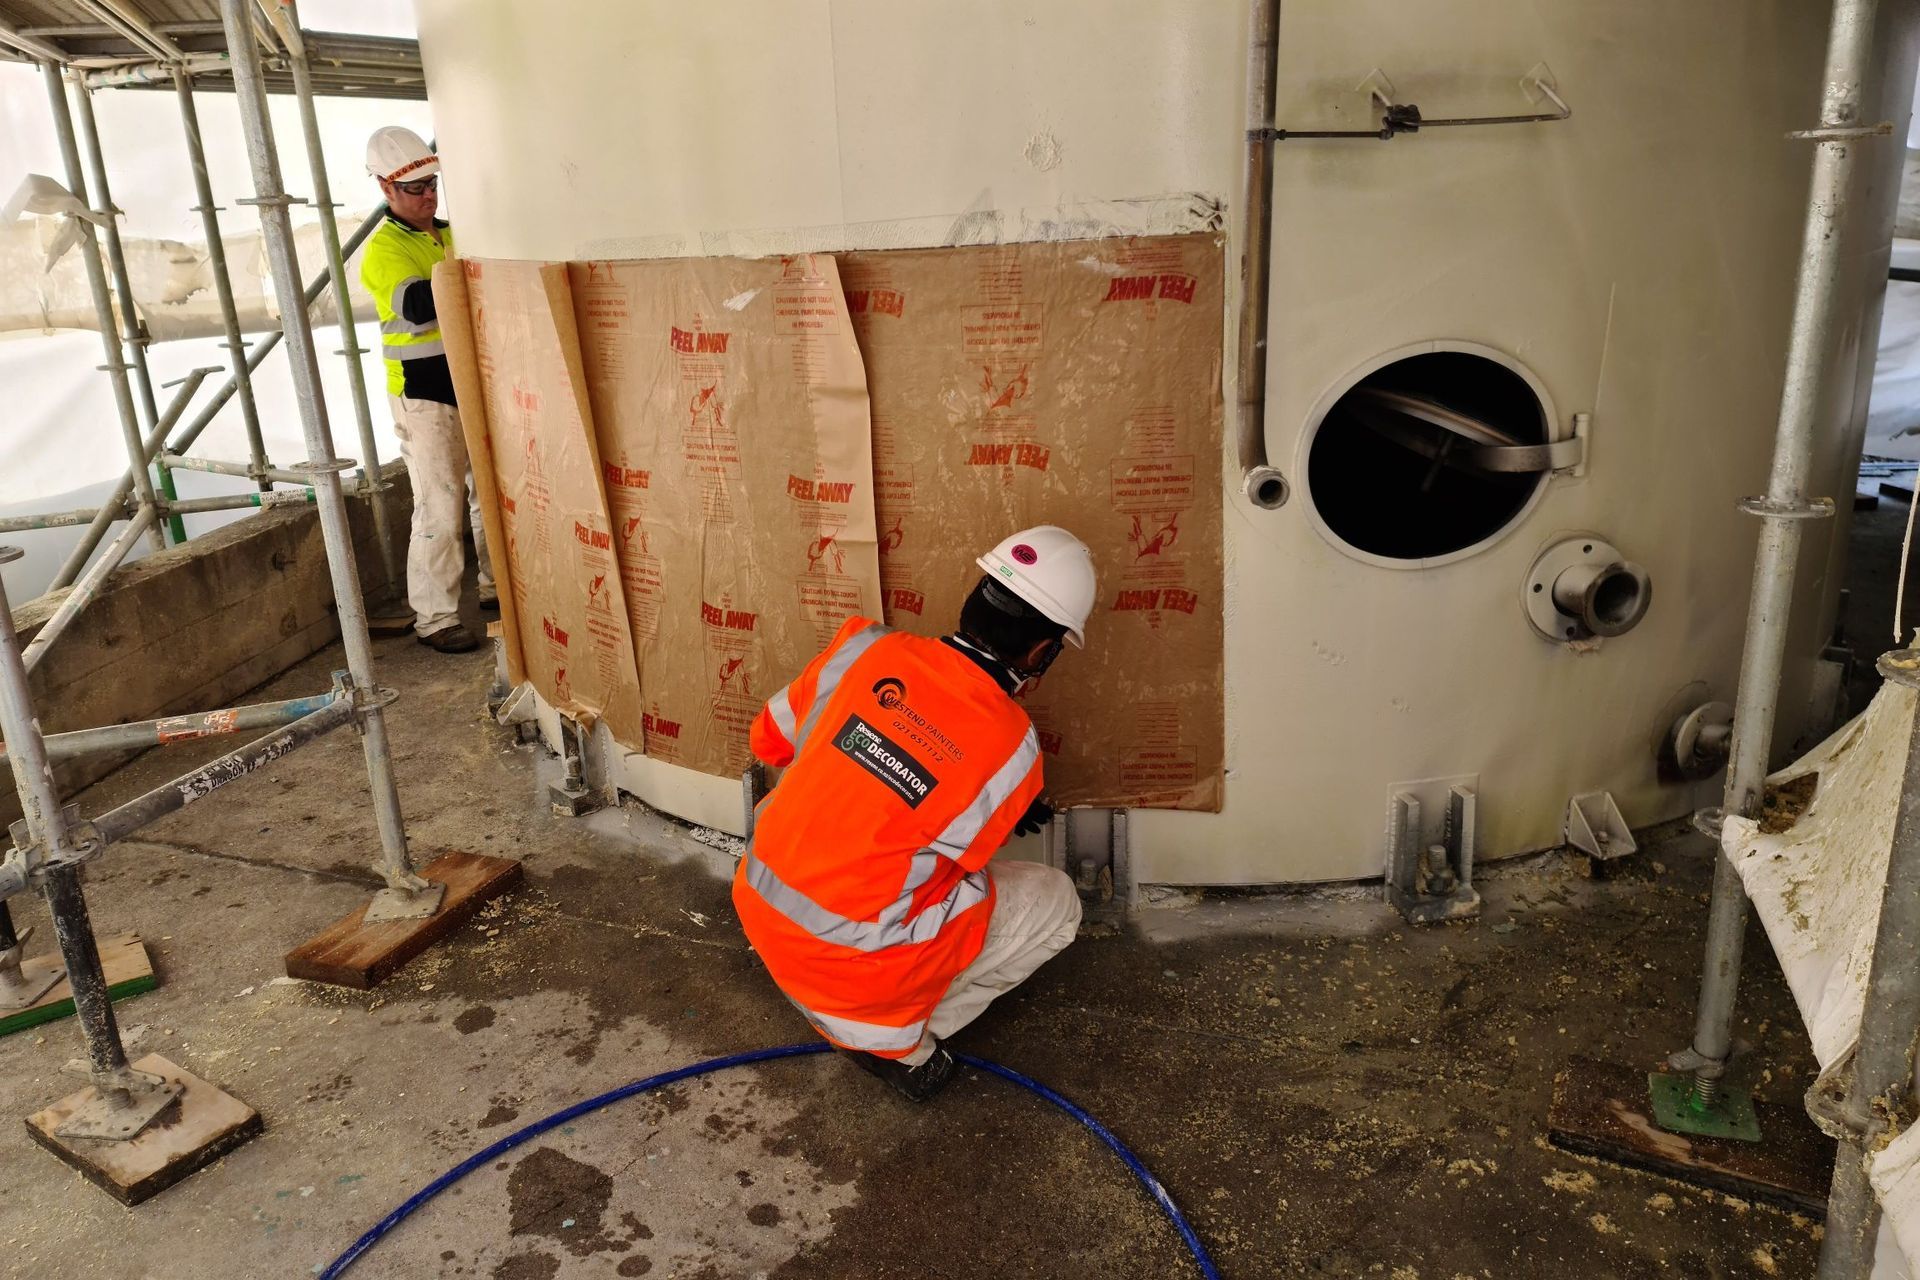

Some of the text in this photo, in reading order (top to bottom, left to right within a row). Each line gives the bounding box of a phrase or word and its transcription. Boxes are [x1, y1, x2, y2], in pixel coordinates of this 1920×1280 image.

[1103, 275, 1197, 304] PEEL AWAY
[872, 290, 905, 318] PEEL
[670, 326, 730, 353] PEEL AWAY
[967, 444, 1051, 472] PEEL AWAY
[787, 473, 854, 504] PEEL AWAY
[575, 520, 610, 551] PEEL AWAY
[701, 600, 724, 627] PEEL
[724, 610, 757, 631] AWAY
[893, 589, 925, 616] PEEL
[1112, 589, 1198, 615] PEEL AWAY
[543, 616, 555, 643] PEEL
[655, 718, 680, 739] AWAY
[855, 722, 883, 746] Resene
[886, 693, 927, 727] WESTEND
[925, 724, 966, 761] PAINTERS
[892, 720, 911, 734] 021
[849, 729, 929, 797] ECODECORATOR
